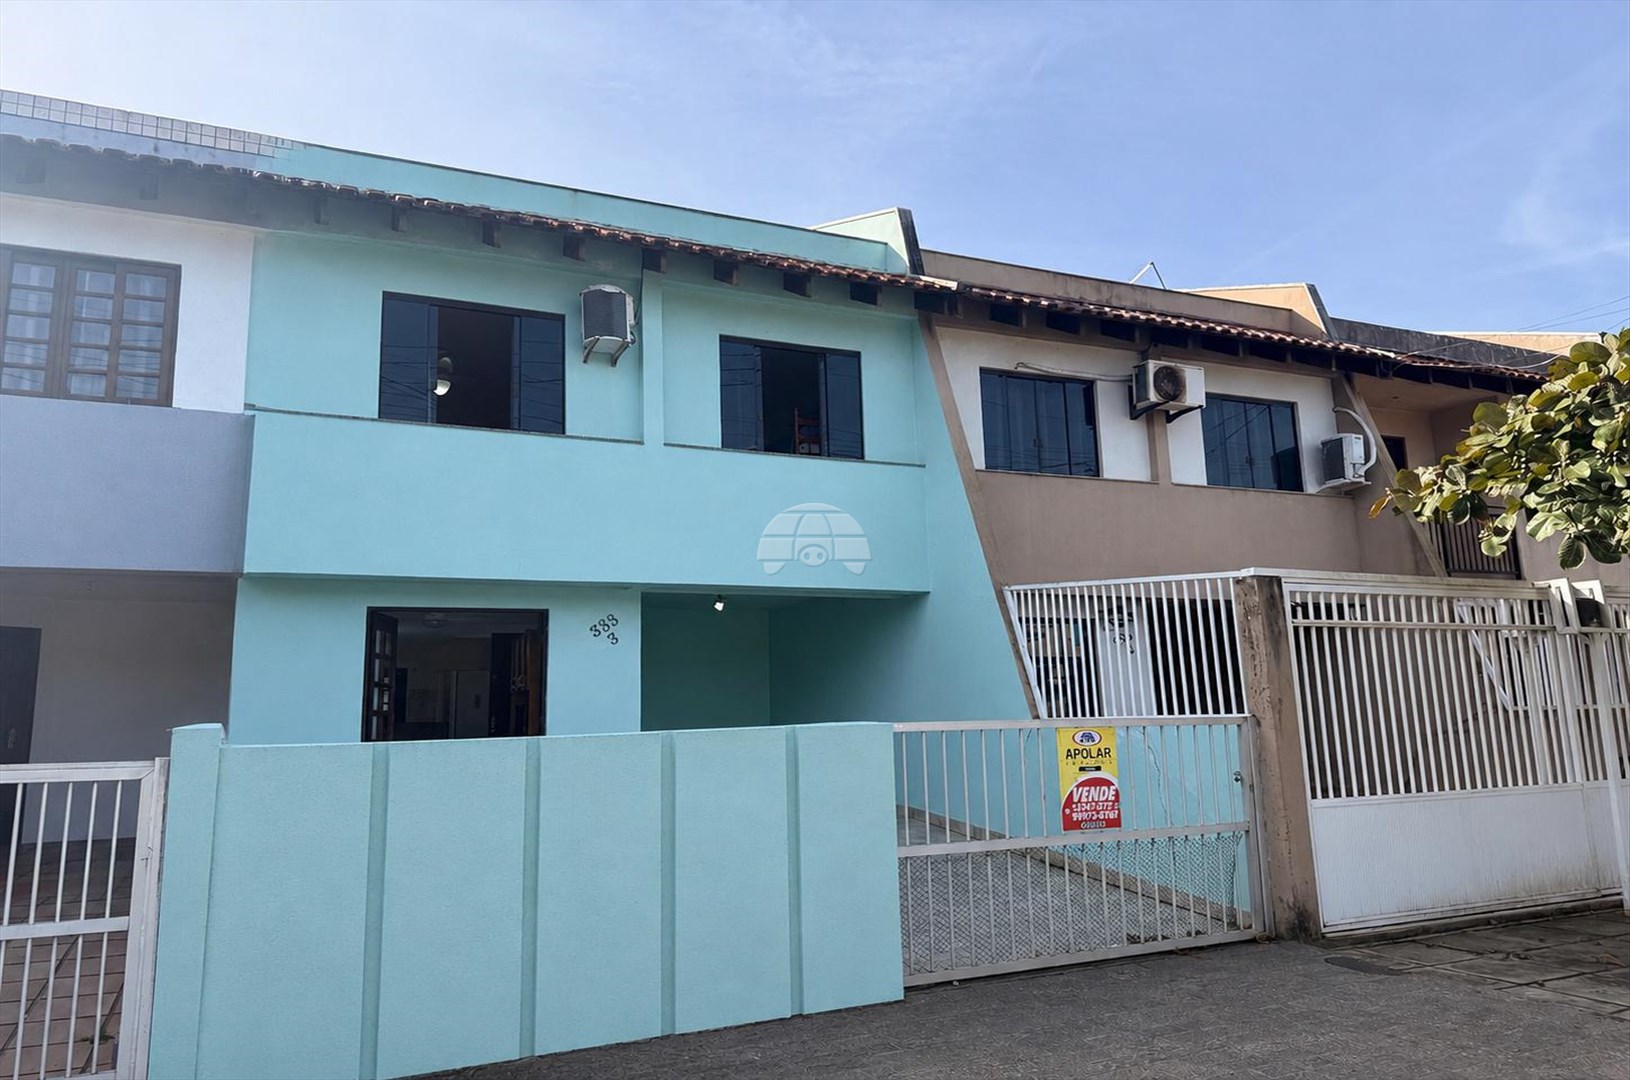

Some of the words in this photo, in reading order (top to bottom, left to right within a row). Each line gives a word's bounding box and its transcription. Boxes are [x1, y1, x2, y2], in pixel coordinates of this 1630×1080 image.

[606, 632, 619, 645] 3
[1065, 747, 1112, 760] APOLAR
[1072, 785, 1117, 802] VENDE
